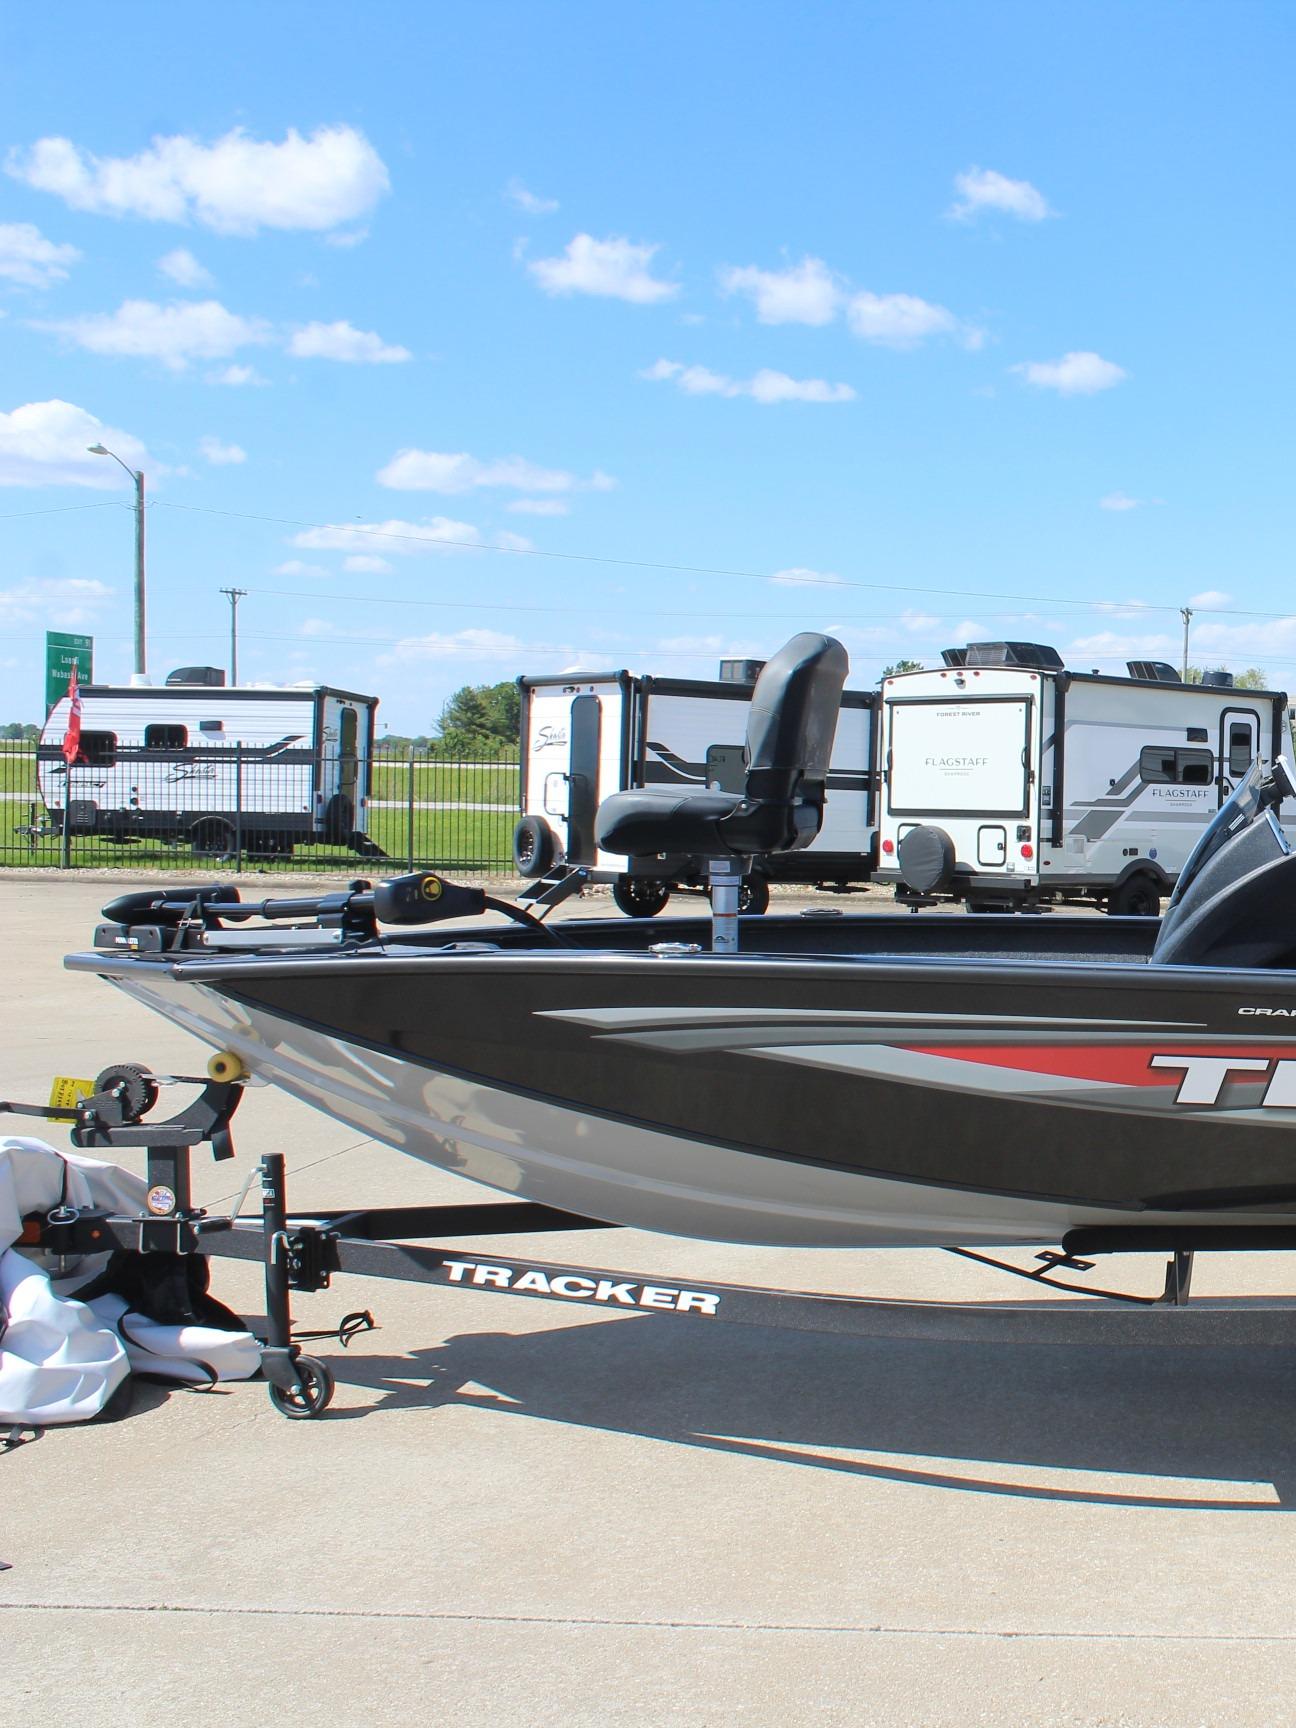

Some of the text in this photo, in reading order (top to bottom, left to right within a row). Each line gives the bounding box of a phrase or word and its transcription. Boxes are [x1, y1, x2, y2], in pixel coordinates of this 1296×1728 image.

[925, 757, 989, 767] FLAGSTAFF
[1152, 788, 1209, 798] FLAGSTAFF
[441, 1260, 721, 1315] TRACKER
